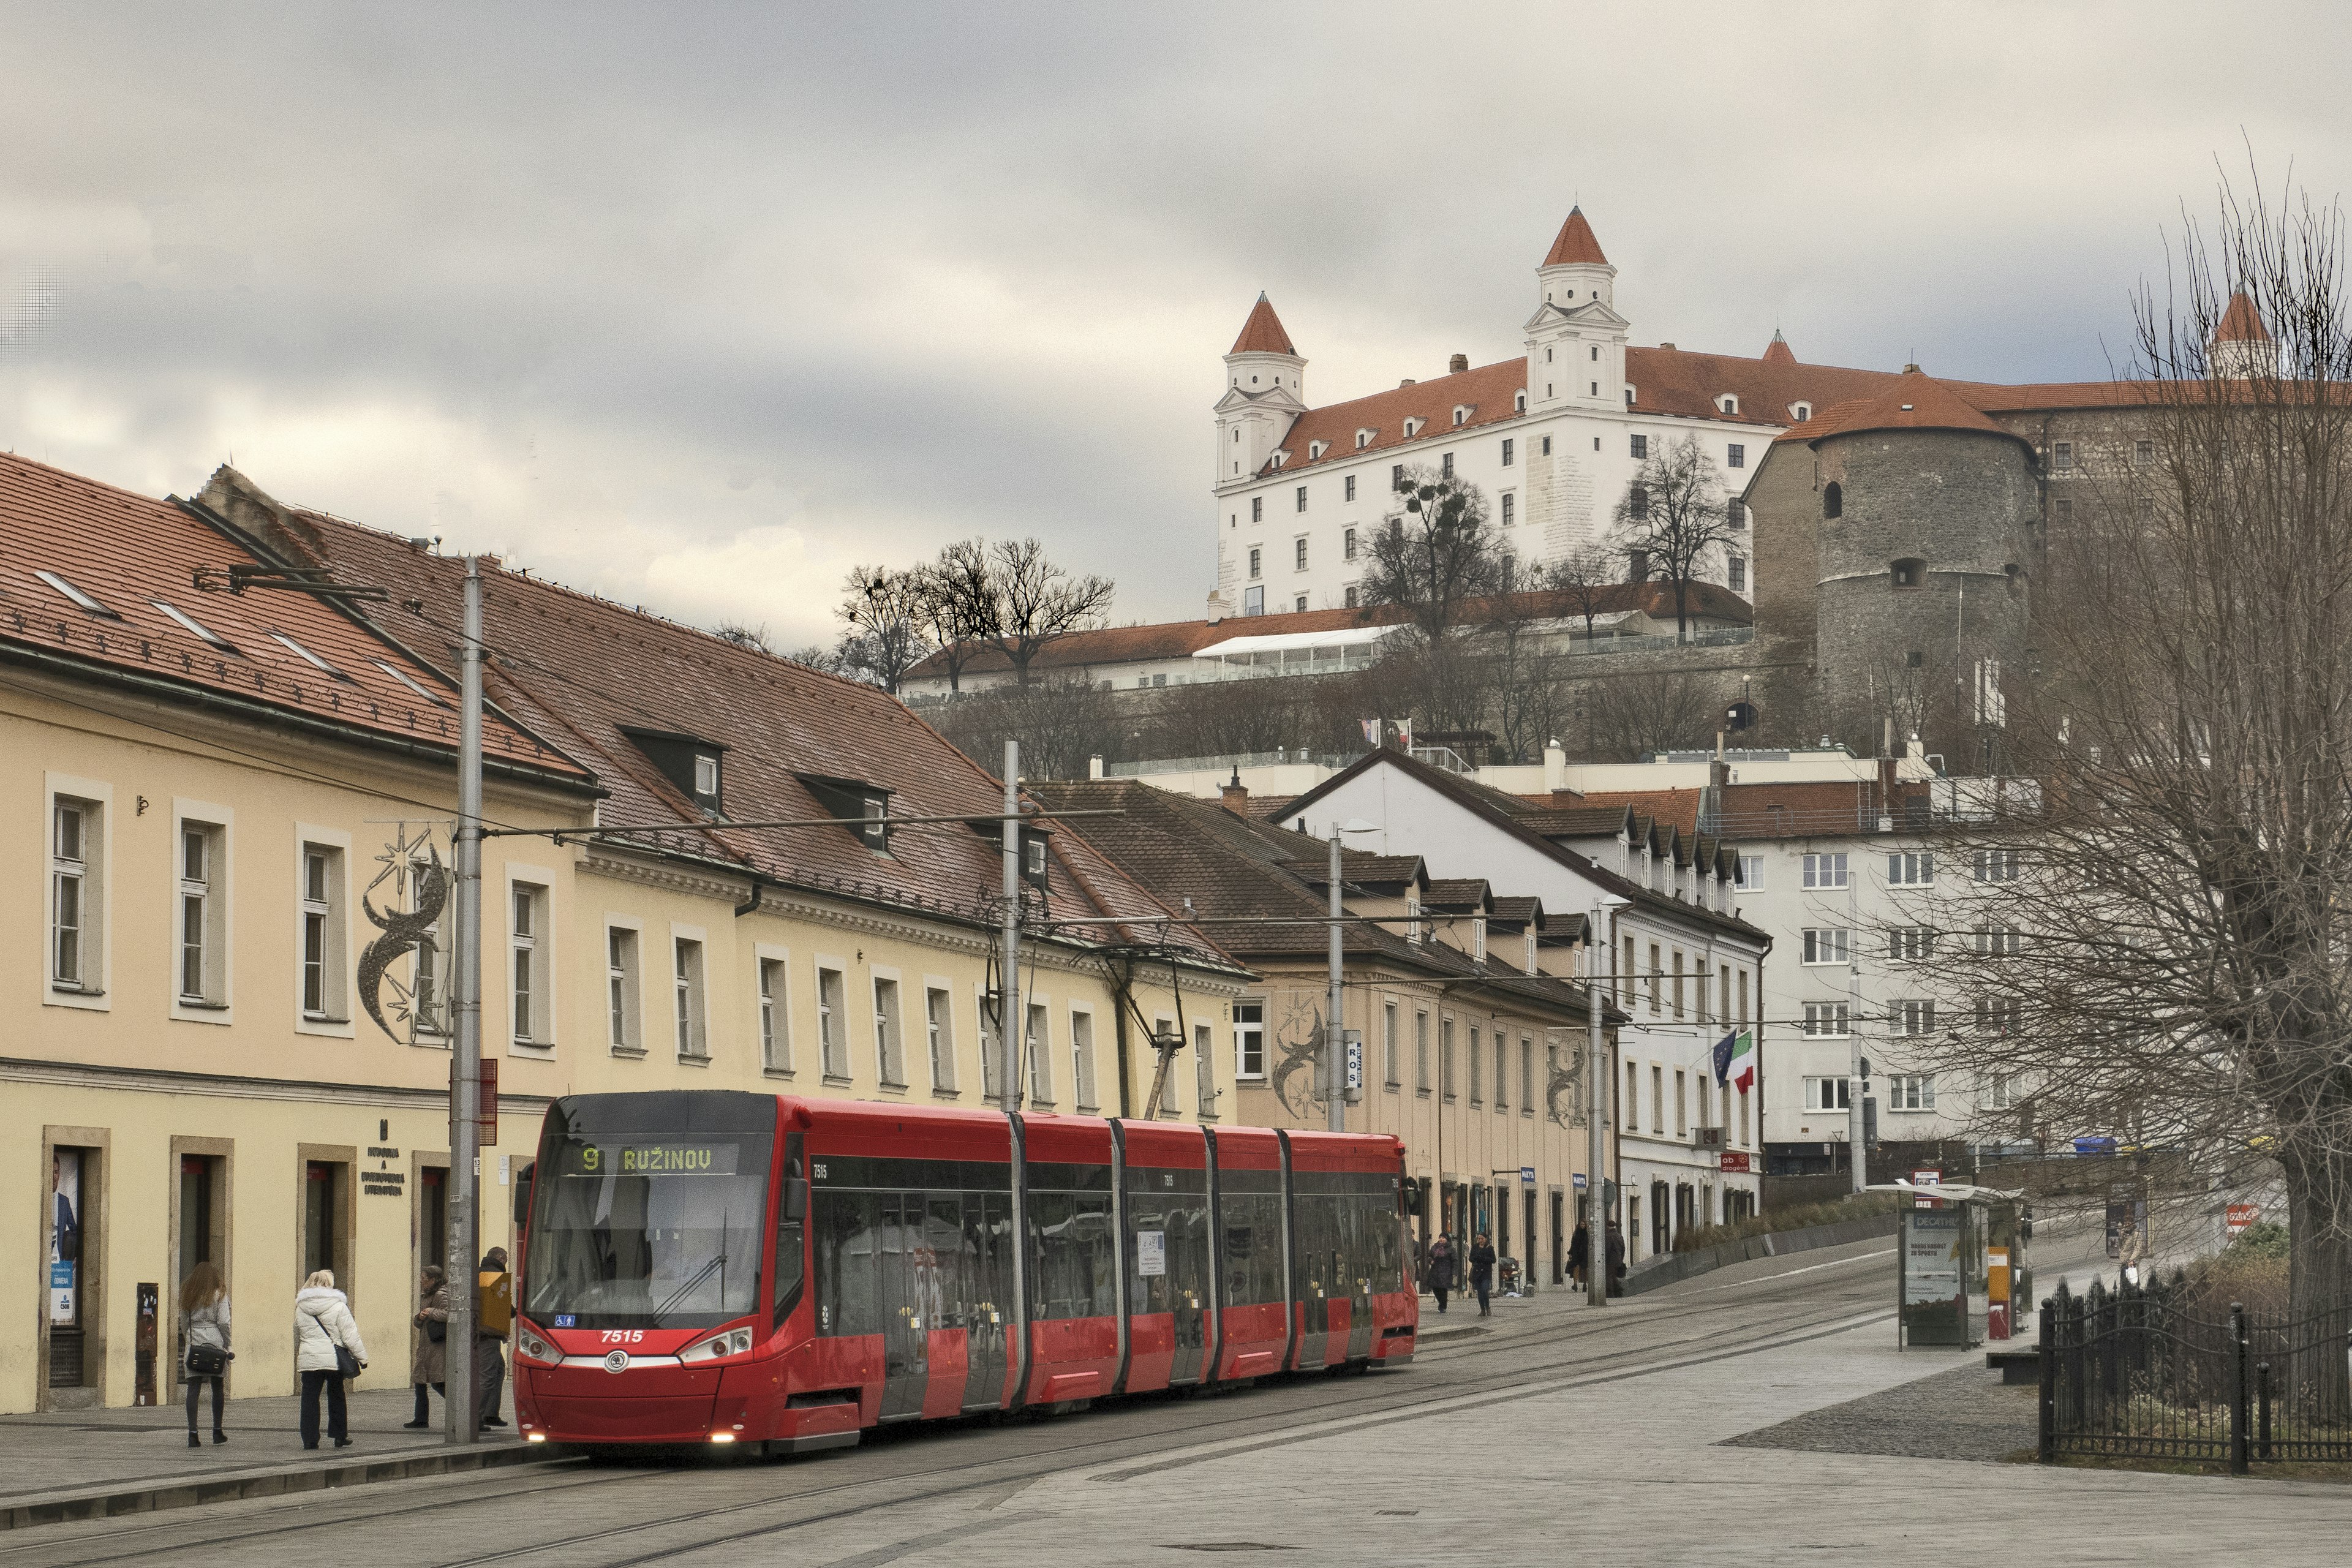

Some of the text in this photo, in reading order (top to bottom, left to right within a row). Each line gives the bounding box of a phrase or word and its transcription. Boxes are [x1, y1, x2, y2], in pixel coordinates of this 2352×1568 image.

[583, 1147, 711, 1170] 9 RUŽINOV
[814, 1164, 827, 1178] 7515
[1164, 1175, 1173, 1186] 7515
[601, 1330, 644, 1343] 7515
